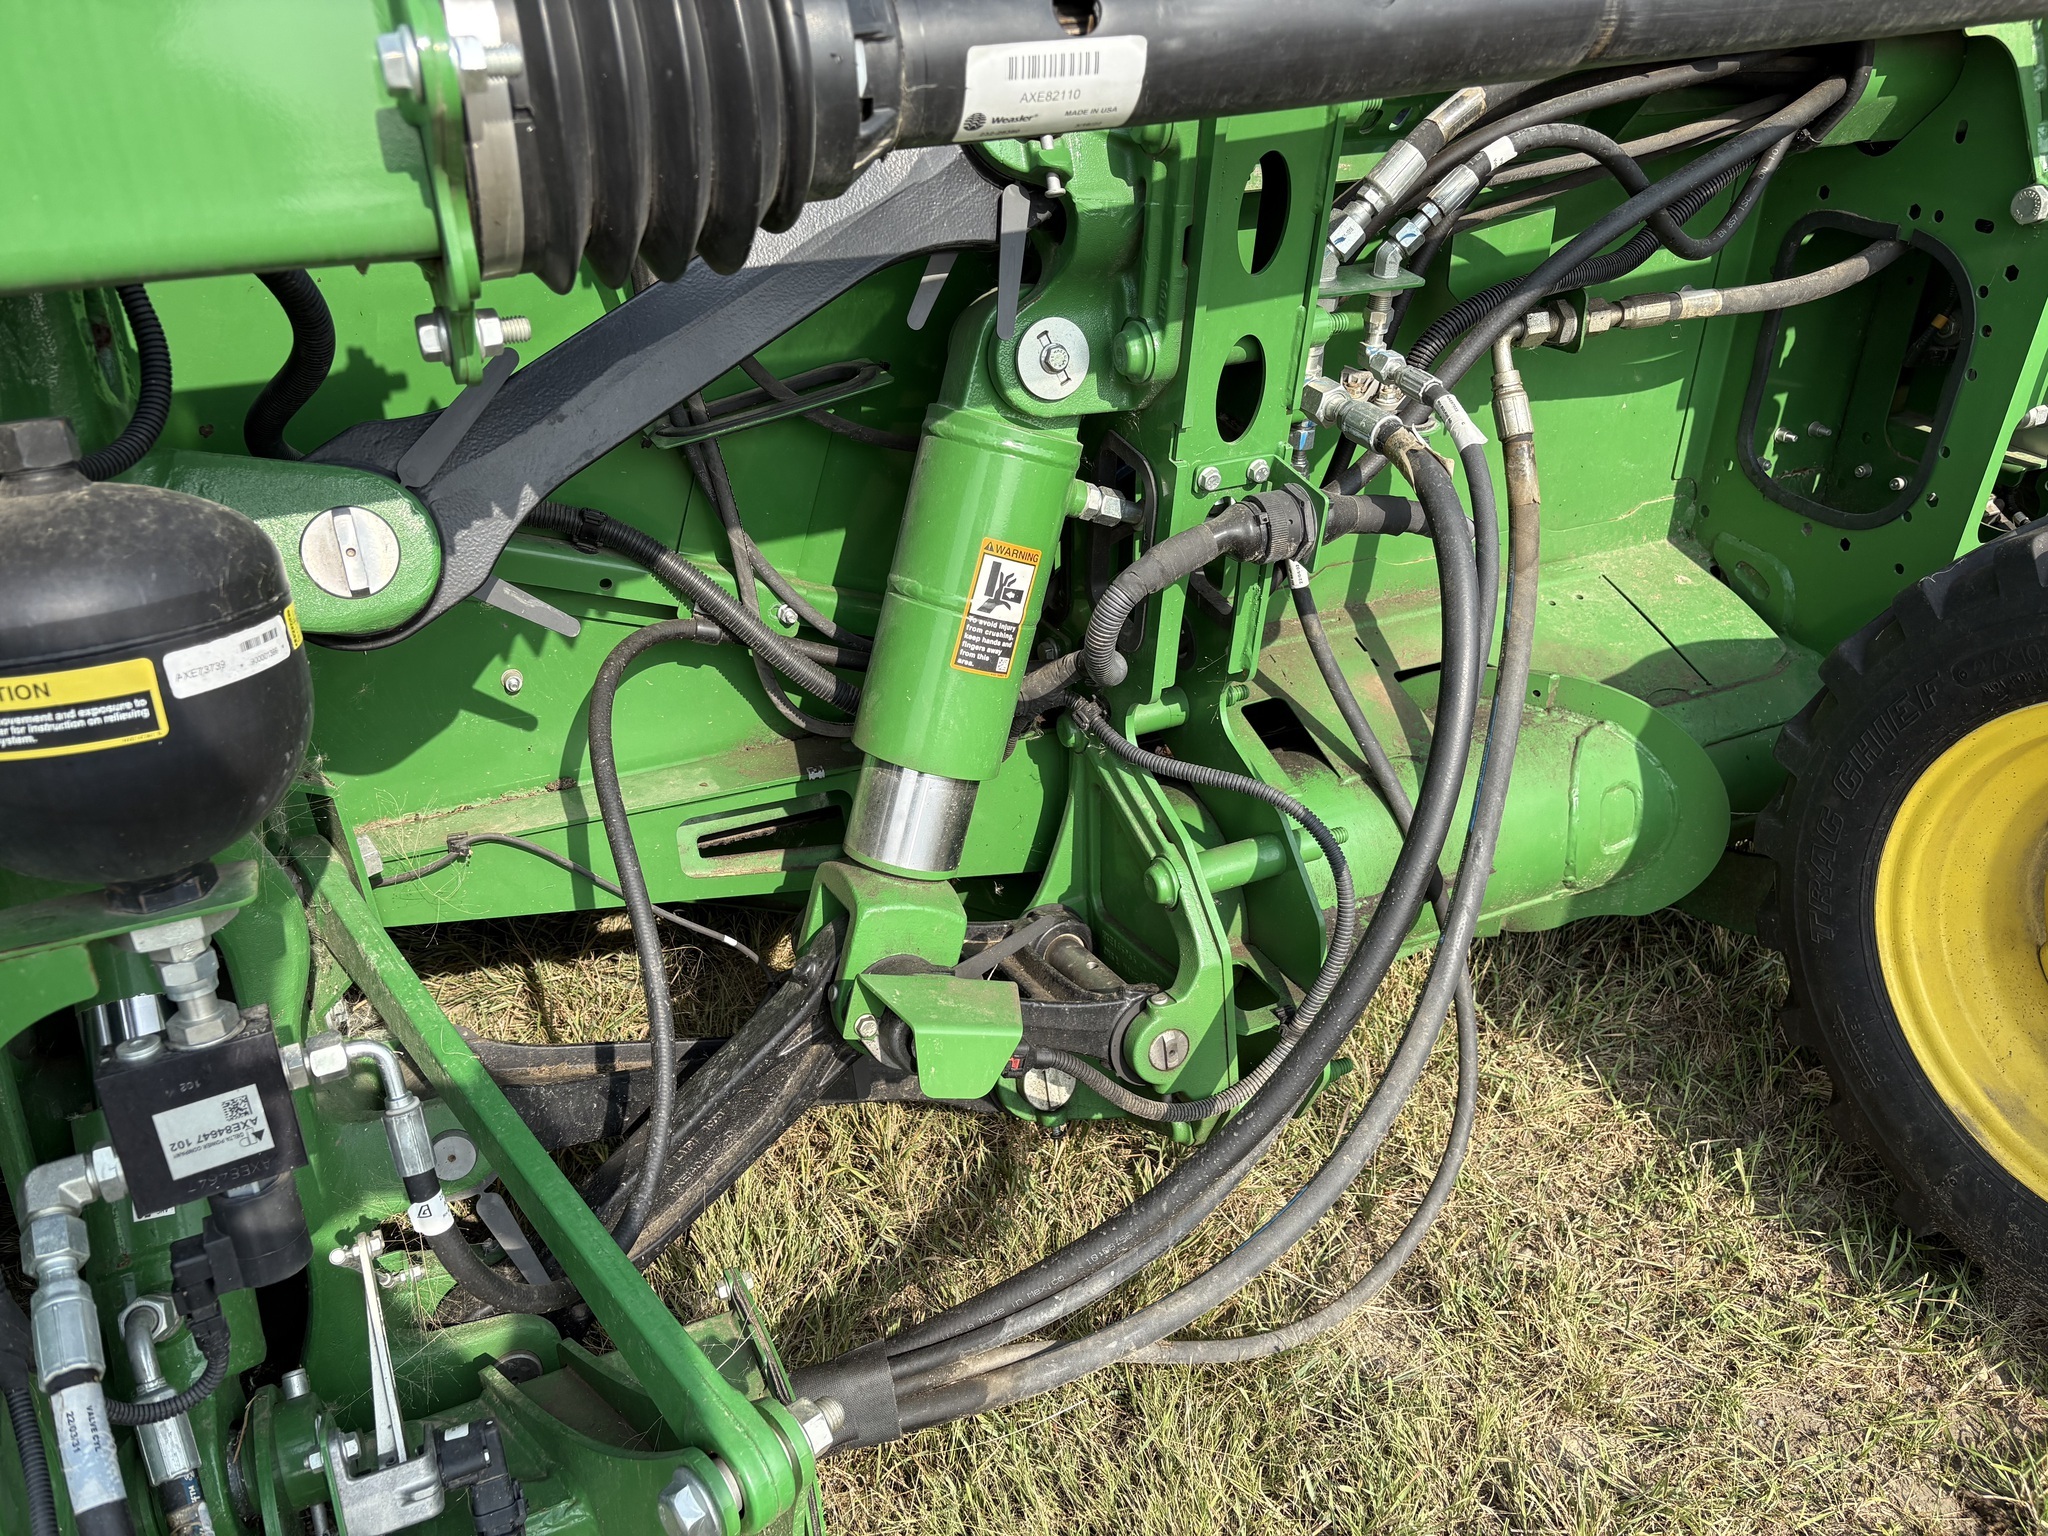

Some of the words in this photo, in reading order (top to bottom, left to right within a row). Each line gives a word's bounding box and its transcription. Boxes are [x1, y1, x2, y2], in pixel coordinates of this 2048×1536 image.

[1019, 89, 1081, 104] AXE82110
[1065, 109, 1089, 117] MADE
[995, 543, 1040, 563] WARNING
[966, 624, 984, 634] from
[979, 618, 998, 629] avoid
[961, 640, 986, 652] fingers
[986, 648, 1003, 657] away
[963, 632, 981, 643] keep
[981, 636, 1002, 648] hands
[1001, 641, 1013, 649] and
[956, 657, 975, 668] area.
[959, 648, 976, 659] from
[976, 653, 990, 662] this
[55, 709, 77, 721] and
[77, 701, 134, 717] exposure
[134, 698, 148, 708] to
[10, 726, 27, 736] for
[28, 718, 86, 734] instruction
[87, 717, 103, 727] on
[104, 707, 150, 724] relieving
[1809, 806, 1845, 943] TRAC
[1833, 672, 1940, 800] CHIEF
[196, 1115, 259, 1145] AXE84647
[169, 1138, 193, 1152] 102
[978, 1306, 1007, 1325] Made
[1026, 1274, 1066, 1299] Mexico
[86, 1405, 99, 1433] VALVE
[92, 1434, 102, 1453] CYL
